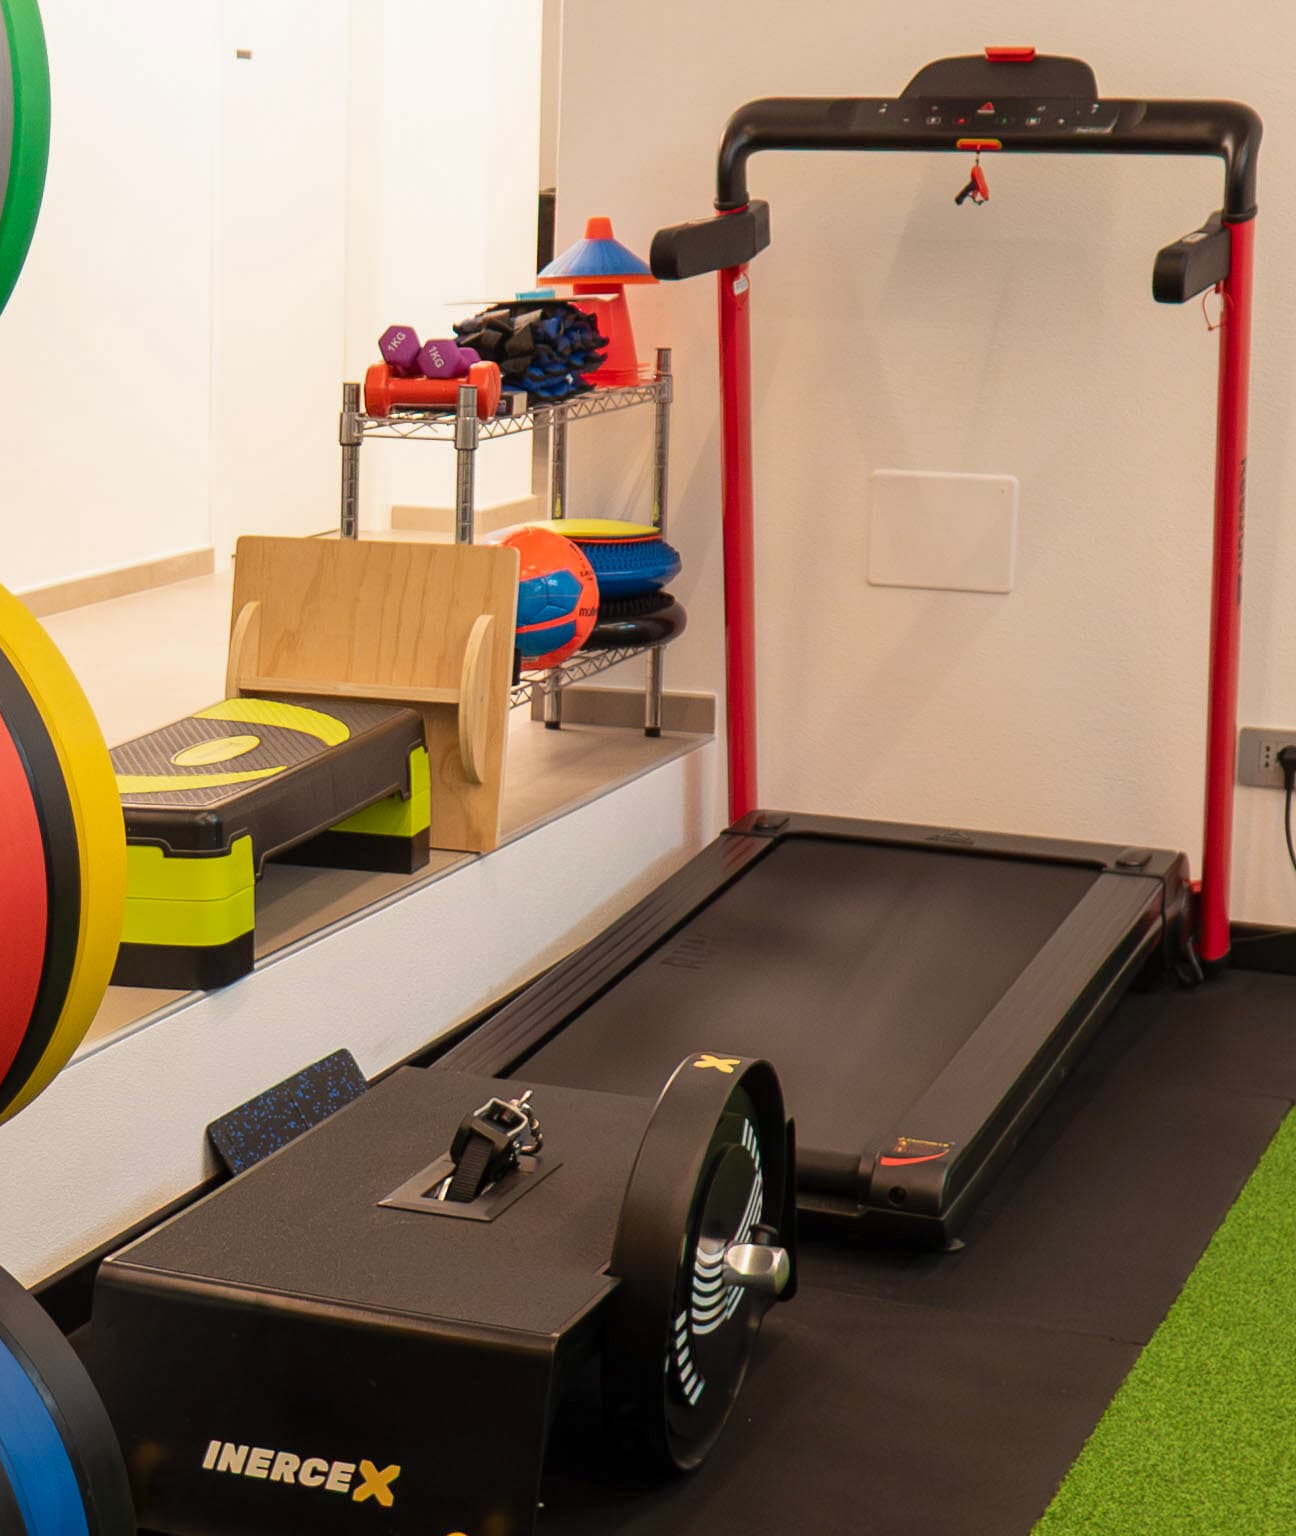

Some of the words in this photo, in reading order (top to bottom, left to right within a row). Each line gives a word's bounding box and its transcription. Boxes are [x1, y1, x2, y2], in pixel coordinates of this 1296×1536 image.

[388, 332, 406, 352] 1KG
[429, 345, 445, 368] 1KG
[202, 1440, 401, 1507] INERCEX
